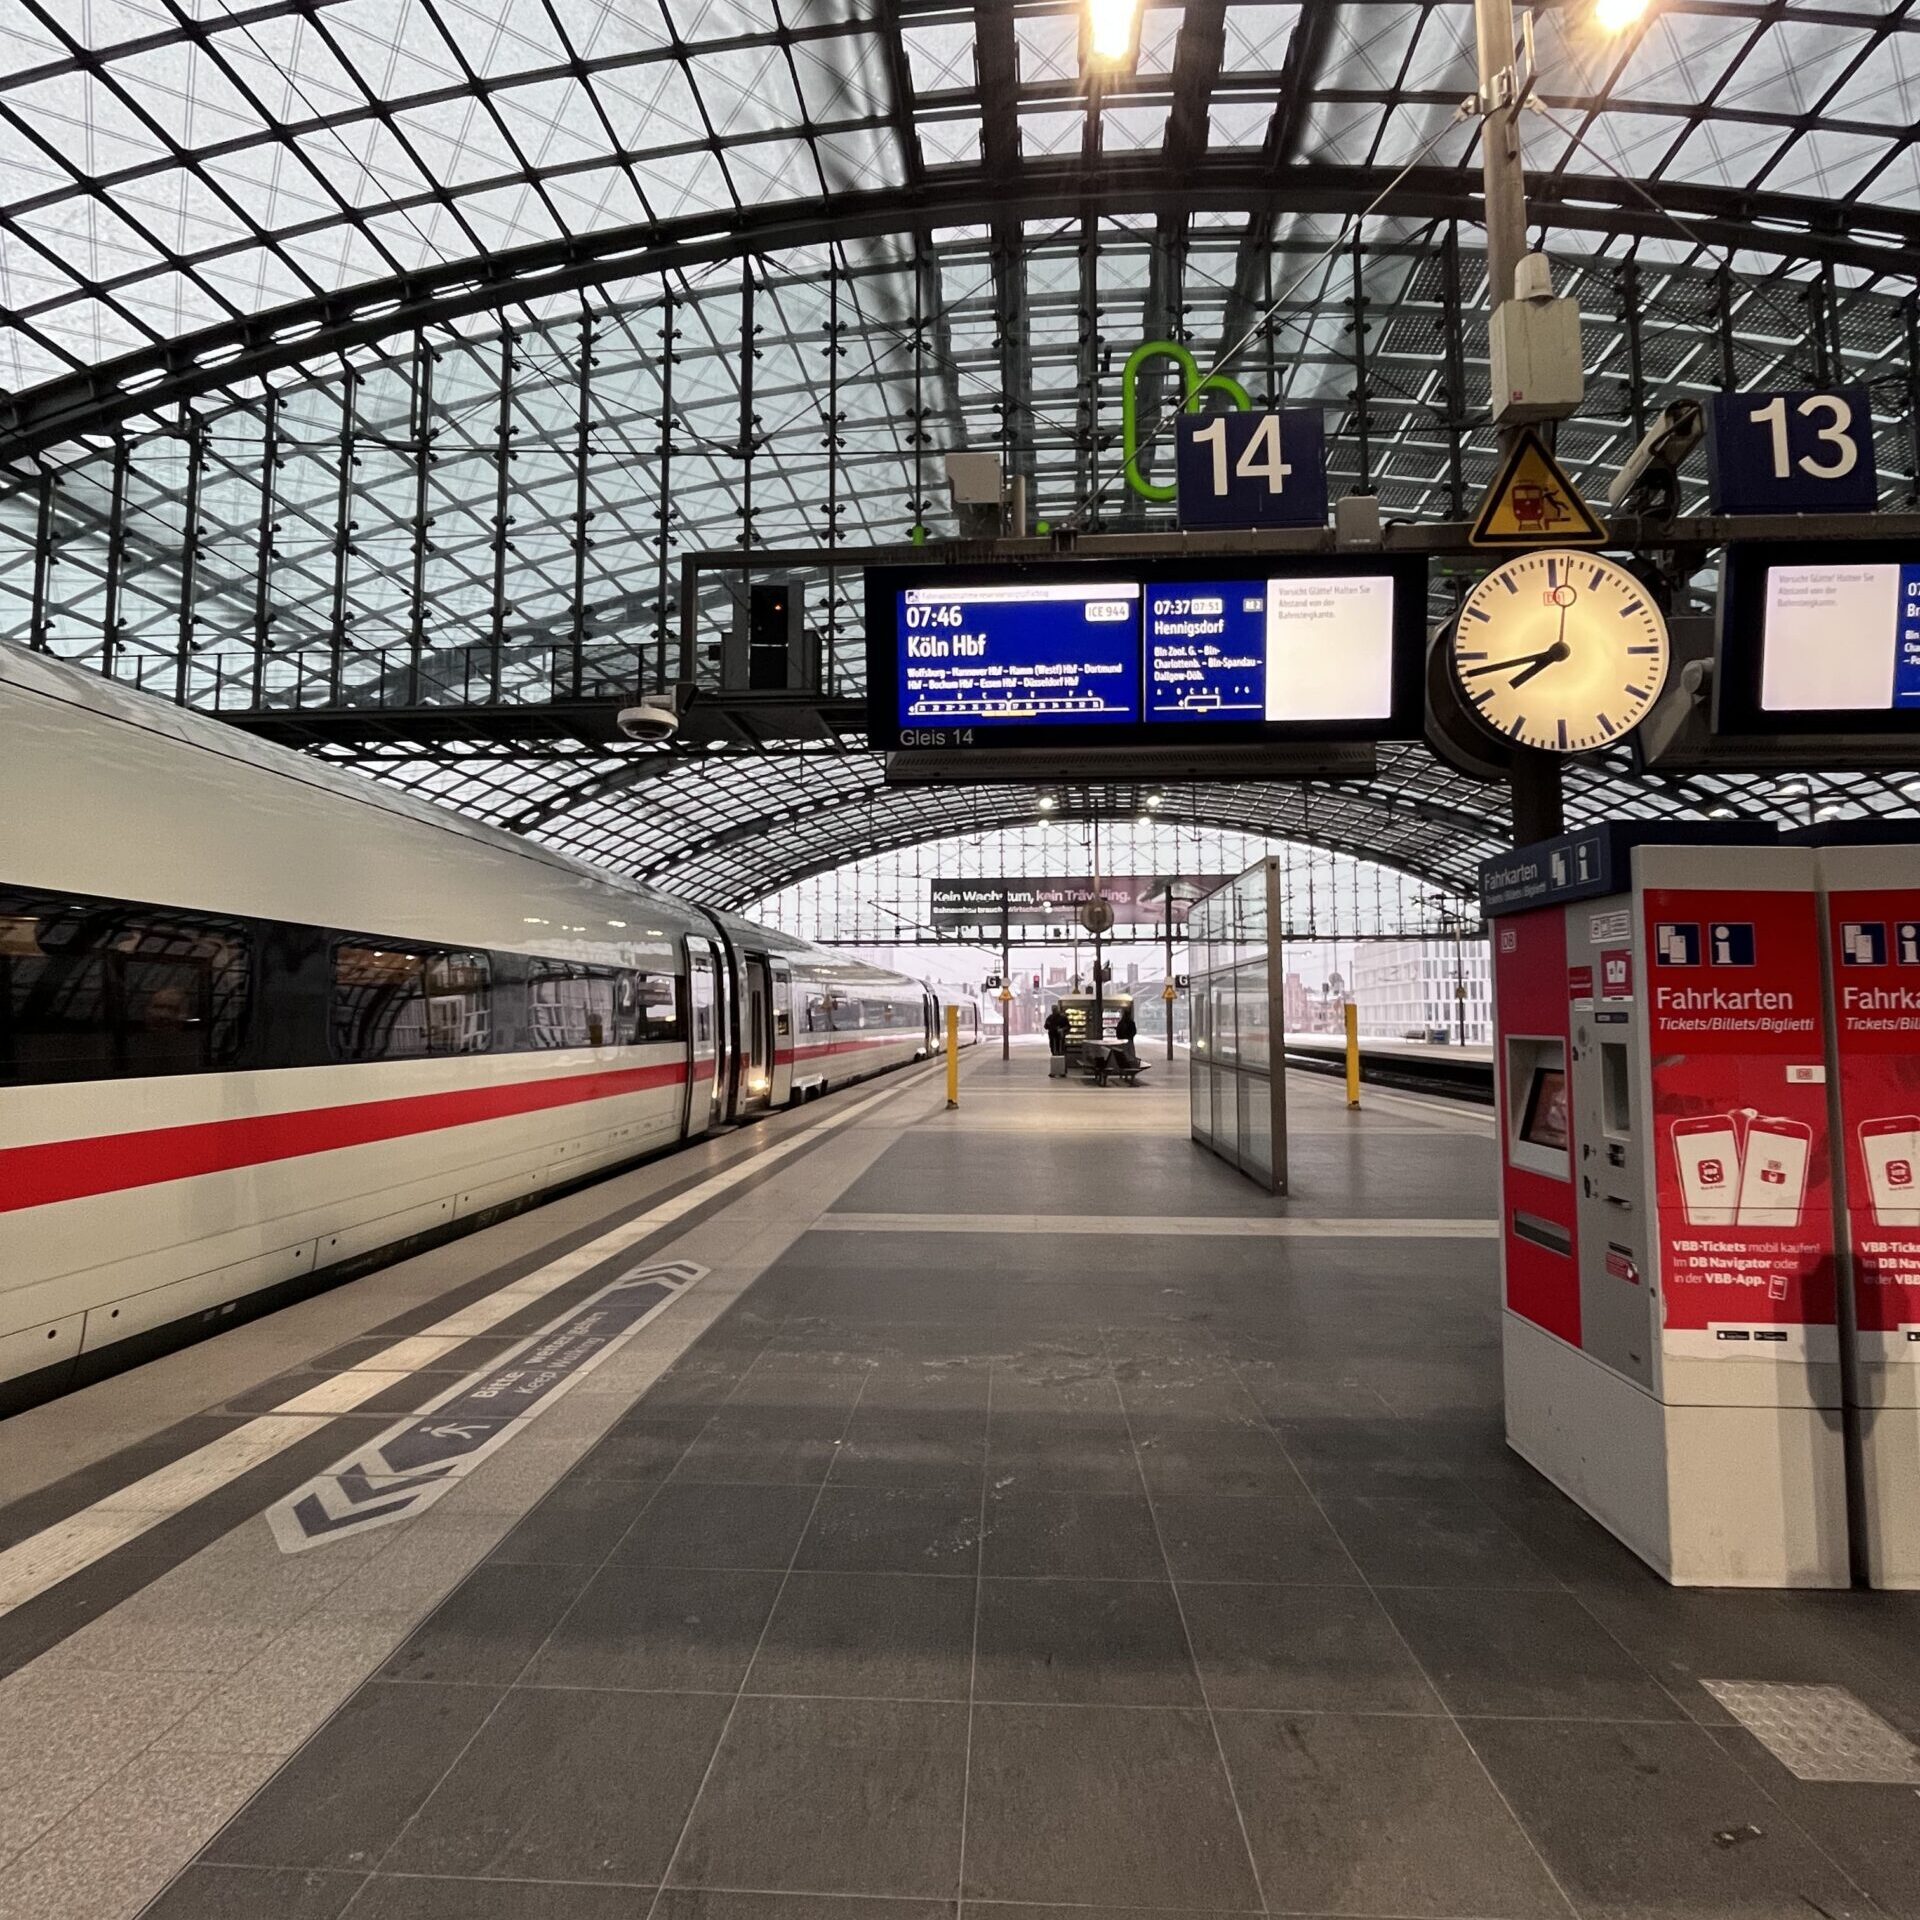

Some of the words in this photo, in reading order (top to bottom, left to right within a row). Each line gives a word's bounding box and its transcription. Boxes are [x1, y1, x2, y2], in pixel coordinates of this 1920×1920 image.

[1749, 395, 1858, 479] 13
[1192, 413, 1292, 496] 14
[1360, 586, 1370, 594] Sie
[1088, 604, 1104, 617] ICE
[1106, 602, 1126, 616] 944
[1154, 600, 1190, 615] 07:37
[1193, 602, 1220, 611] 07:51
[907, 606, 962, 628] 07:46
[1154, 619, 1224, 637] Hennigsdorf
[908, 636, 949, 657] Köln
[953, 634, 986, 656] Hbf
[1208, 657, 1256, 669] Bln-Spandau
[907, 668, 946, 679] Wolfsburg
[952, 667, 988, 677] Hannover
[988, 666, 1003, 676] Hbf
[1009, 665, 1034, 676] Hamm
[1063, 664, 1077, 674] Hbf
[1084, 663, 1122, 674] Dortmund
[908, 679, 922, 690] Hbf
[929, 679, 958, 689] Bochum
[959, 678, 973, 689] Hbf
[980, 678, 1002, 689] Essen
[1002, 678, 1017, 688] Hbf
[1023, 676, 1064, 688] Düsseldorf
[1064, 676, 1079, 687] Hbf
[900, 730, 946, 746] Gleis
[953, 729, 974, 745] 14
[1484, 864, 1538, 891] Fahrkarten
[933, 890, 960, 902] Kein
[1036, 890, 1063, 901] kein
[988, 976, 996, 986] G
[1180, 976, 1187, 985] G
[622, 979, 631, 1006] 2
[1657, 987, 1793, 1010] Fahrkarten
[1659, 1017, 1814, 1033] Tickets/Billets/Biglietti
[1672, 1240, 1746, 1252] VBB-Tickets
[1750, 1242, 1778, 1252] mobil
[1781, 1242, 1820, 1253] kaufen!
[1674, 1258, 1687, 1267] Im
[1690, 1257, 1708, 1268] DB
[1710, 1257, 1771, 1271] Navigator
[1773, 1259, 1798, 1269] oder
[1879, 1258, 1897, 1268] DB
[1674, 1274, 1683, 1283] in
[1684, 1274, 1702, 1284] der
[1704, 1273, 1765, 1287] VBB-App.
[470, 1371, 525, 1398] Bitte
[524, 1336, 575, 1364] weiter
[514, 1371, 556, 1394] Keep
[548, 1337, 606, 1368] Walking
